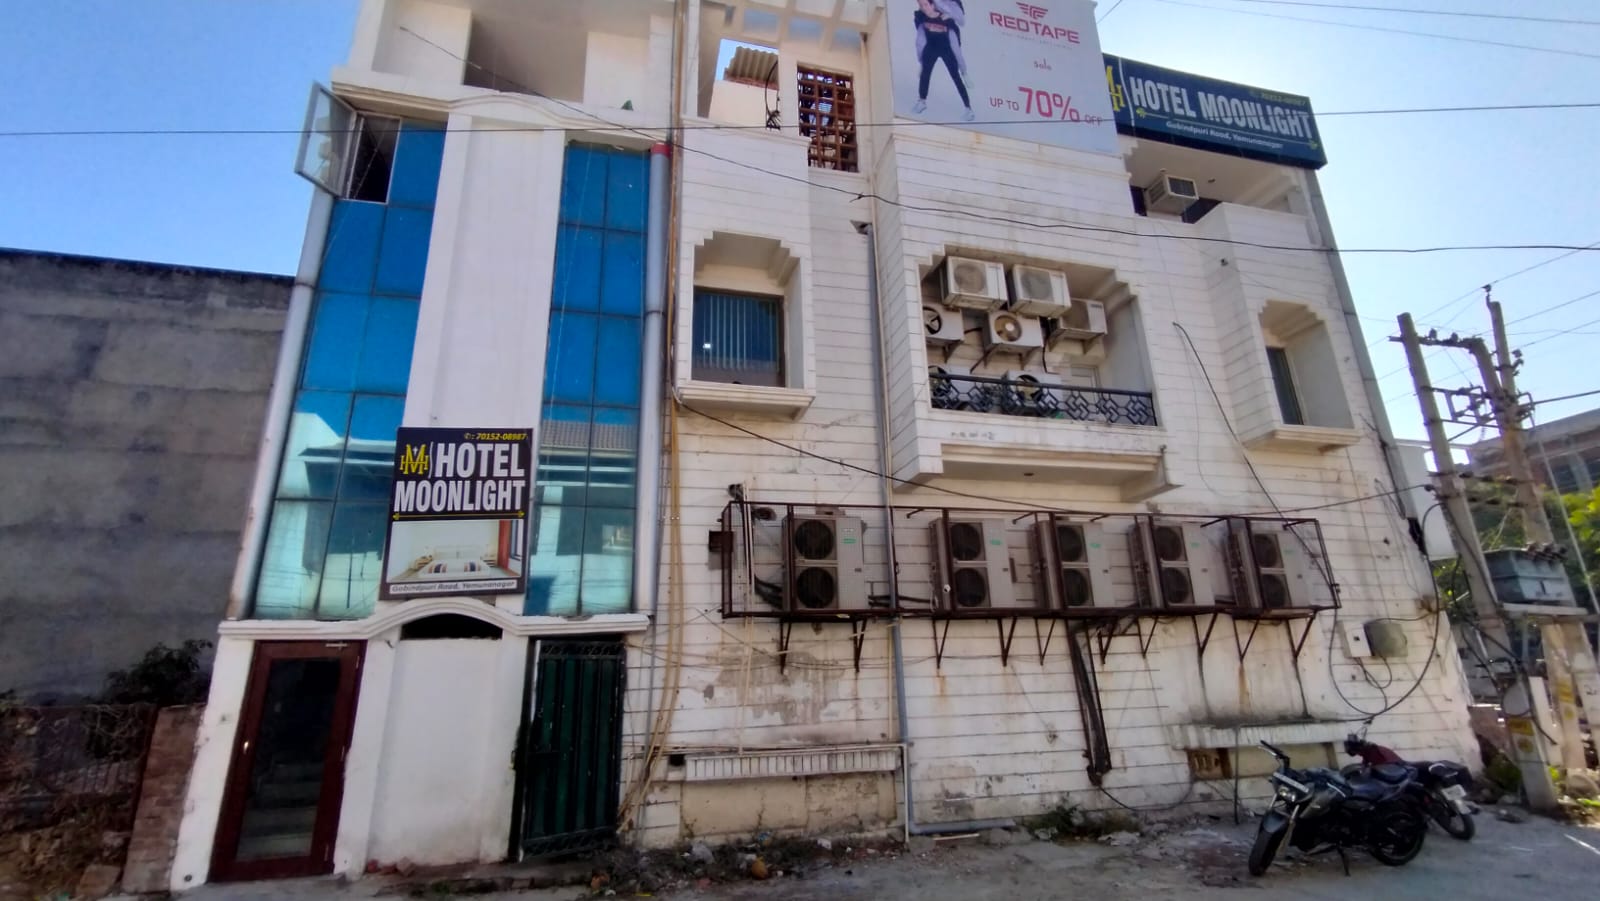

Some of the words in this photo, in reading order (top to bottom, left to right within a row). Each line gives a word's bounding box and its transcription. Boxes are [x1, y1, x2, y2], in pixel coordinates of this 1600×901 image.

[990, 12, 1080, 44] REDTAPE
[990, 96, 1003, 108] UP
[1006, 100, 1020, 111] TO
[1018, 86, 1080, 122] 70%
[1129, 76, 1197, 118] HOTEL
[1198, 91, 1313, 139] MOONLIGHT
[434, 442, 525, 478] HOTEL
[393, 480, 526, 512] MOONLIGHT
